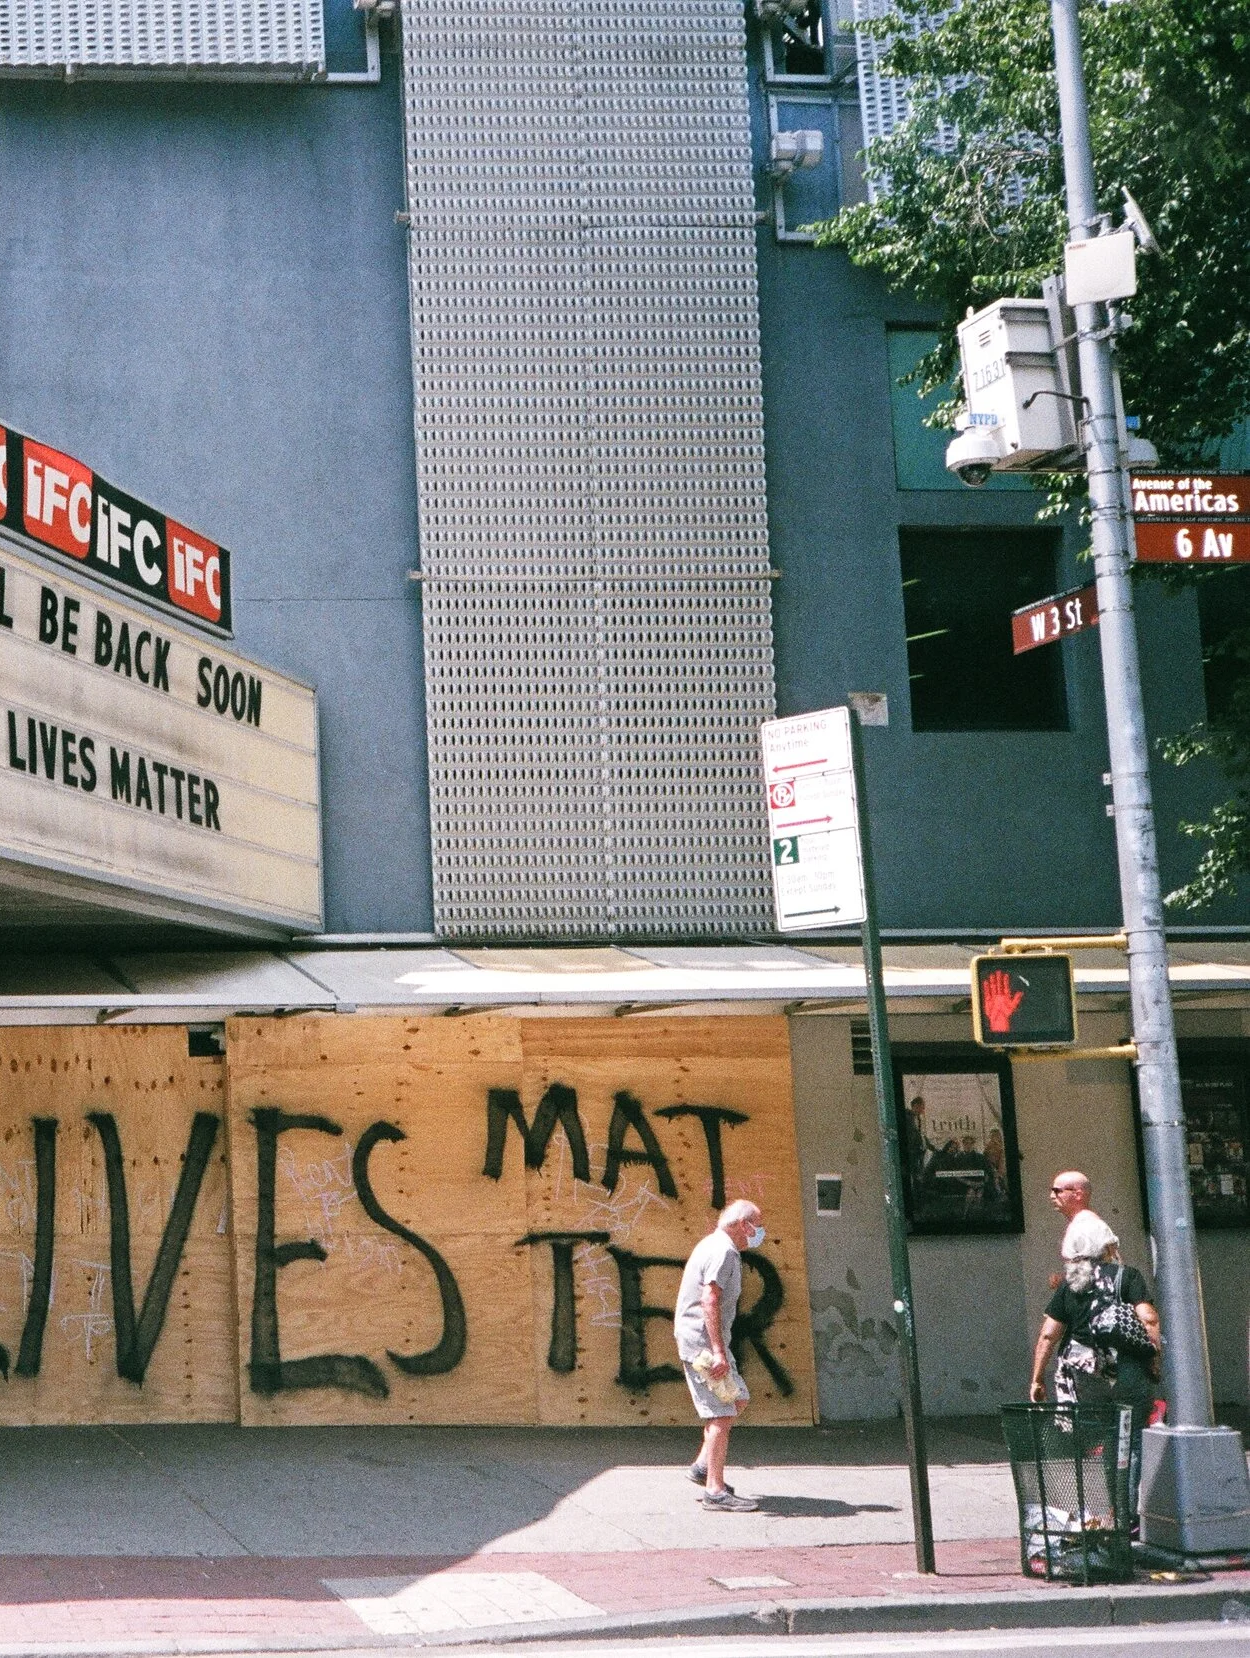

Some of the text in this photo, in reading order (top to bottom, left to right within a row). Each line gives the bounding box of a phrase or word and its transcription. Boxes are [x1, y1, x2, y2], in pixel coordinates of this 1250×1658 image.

[968, 413, 998, 426] NYPD
[1132, 477, 1213, 490] Avenue of the
[1134, 488, 1240, 513] Americas
[1176, 528, 1234, 558] 6 Av
[1029, 611, 1046, 642] W
[1050, 606, 1061, 635] 3
[1065, 597, 1083, 630] St
[38, 585, 79, 654] BE
[94, 610, 172, 694] BACK
[196, 655, 262, 728] SOON
[767, 719, 828, 740] NO PARKING
[7, 708, 98, 793] LIVES
[109, 745, 222, 832] MATTER
[779, 838, 795, 865] 2
[483, 1081, 750, 1210] MAT
